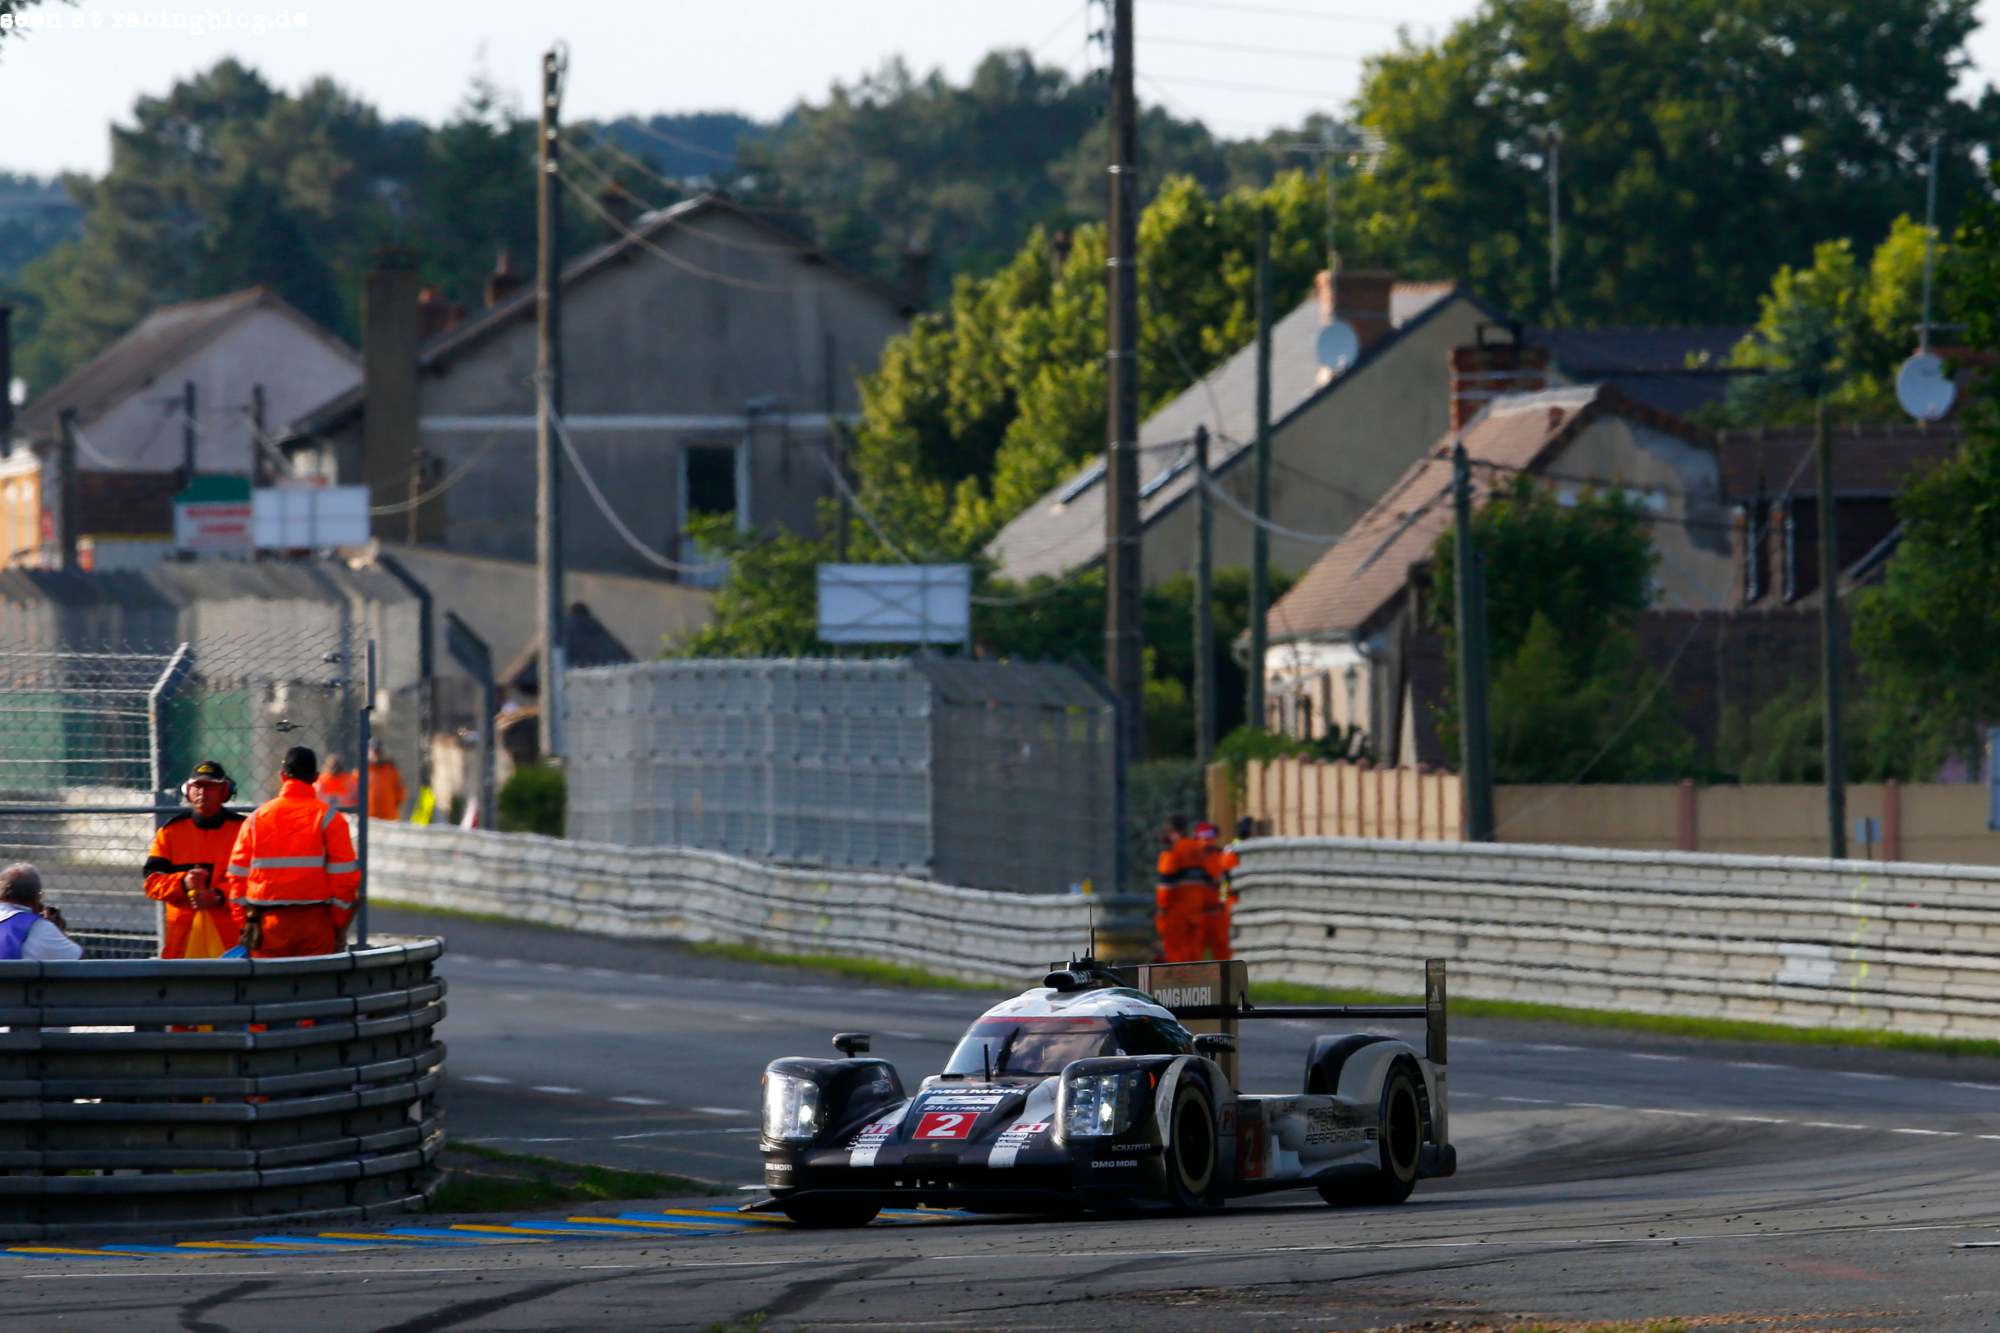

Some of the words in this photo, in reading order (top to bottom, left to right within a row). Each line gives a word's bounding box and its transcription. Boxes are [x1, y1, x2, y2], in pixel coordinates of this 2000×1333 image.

[1154, 988, 1181, 1008] DMG
[1182, 986, 1211, 1007] MORI
[926, 1114, 964, 1137] 2
